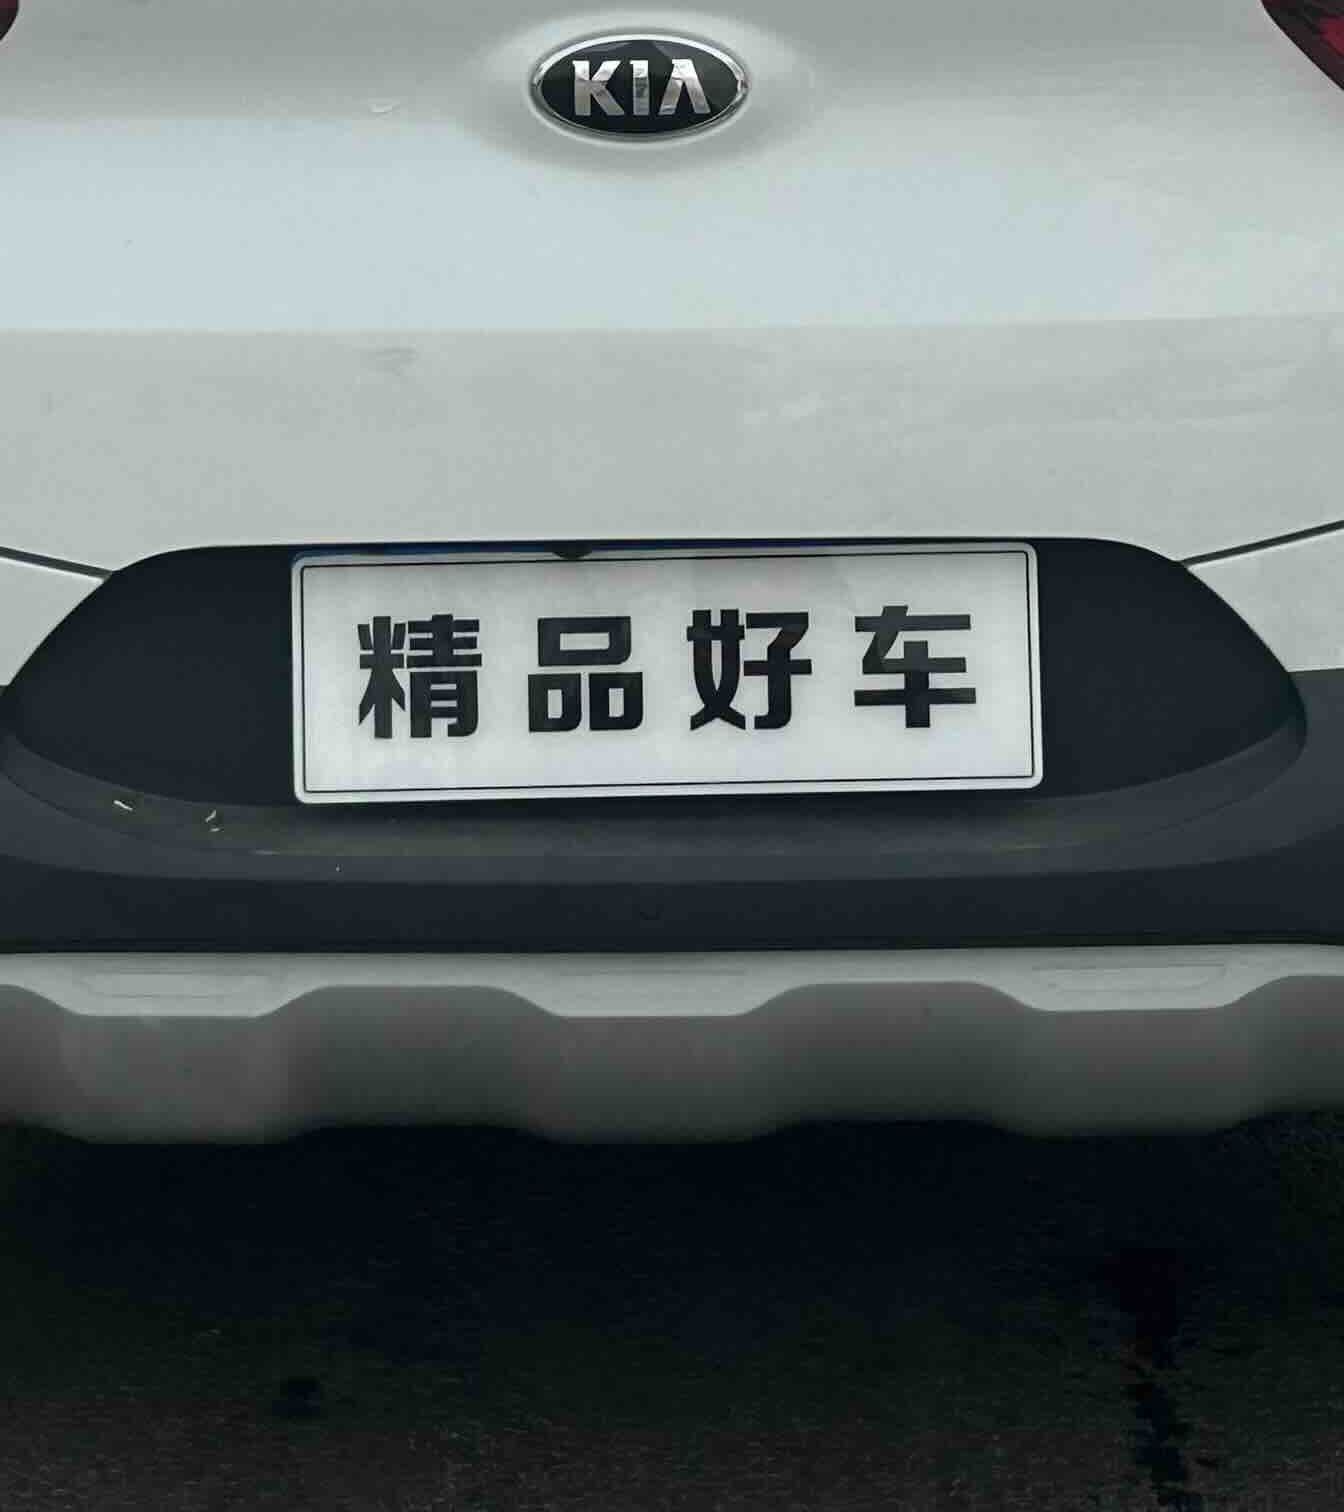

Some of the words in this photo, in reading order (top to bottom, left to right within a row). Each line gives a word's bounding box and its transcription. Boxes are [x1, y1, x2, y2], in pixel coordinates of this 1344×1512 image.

[571, 58, 712, 117] KIA
[356, 604, 978, 740] 精品好车
